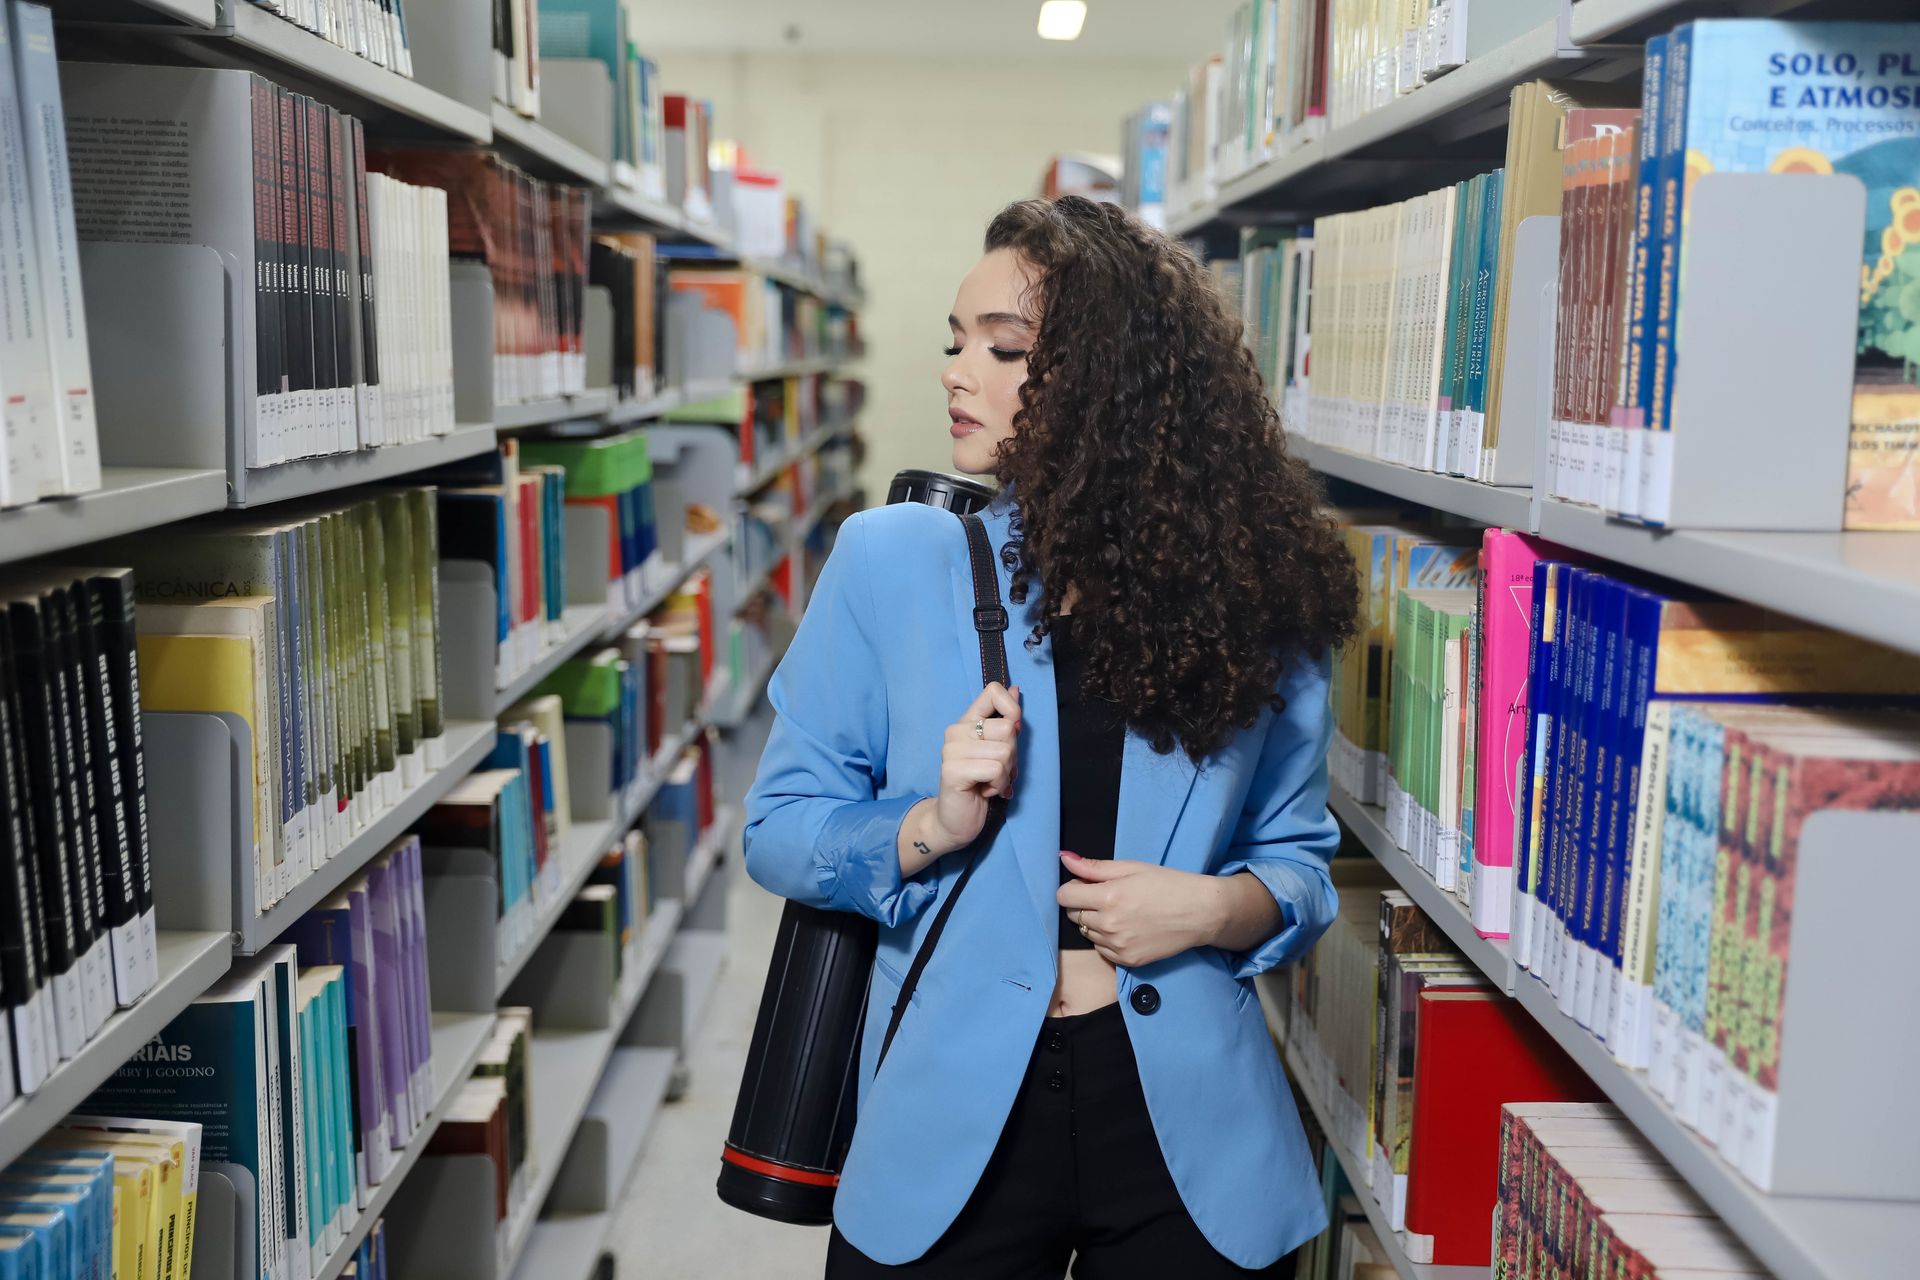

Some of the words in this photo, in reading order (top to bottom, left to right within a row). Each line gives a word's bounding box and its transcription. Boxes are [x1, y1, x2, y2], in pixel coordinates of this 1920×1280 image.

[1768, 52, 1864, 80] SOLO,
[1769, 86, 1786, 108] E
[1475, 269, 1489, 380] AGROINDUSTRIAL
[110, 758, 121, 796] DOS
[136, 752, 144, 789] DOS
[115, 801, 133, 902] MATERIAIS
[138, 794, 150, 893] MATERIAIS
[156, 1066, 215, 1078] GOODNO
